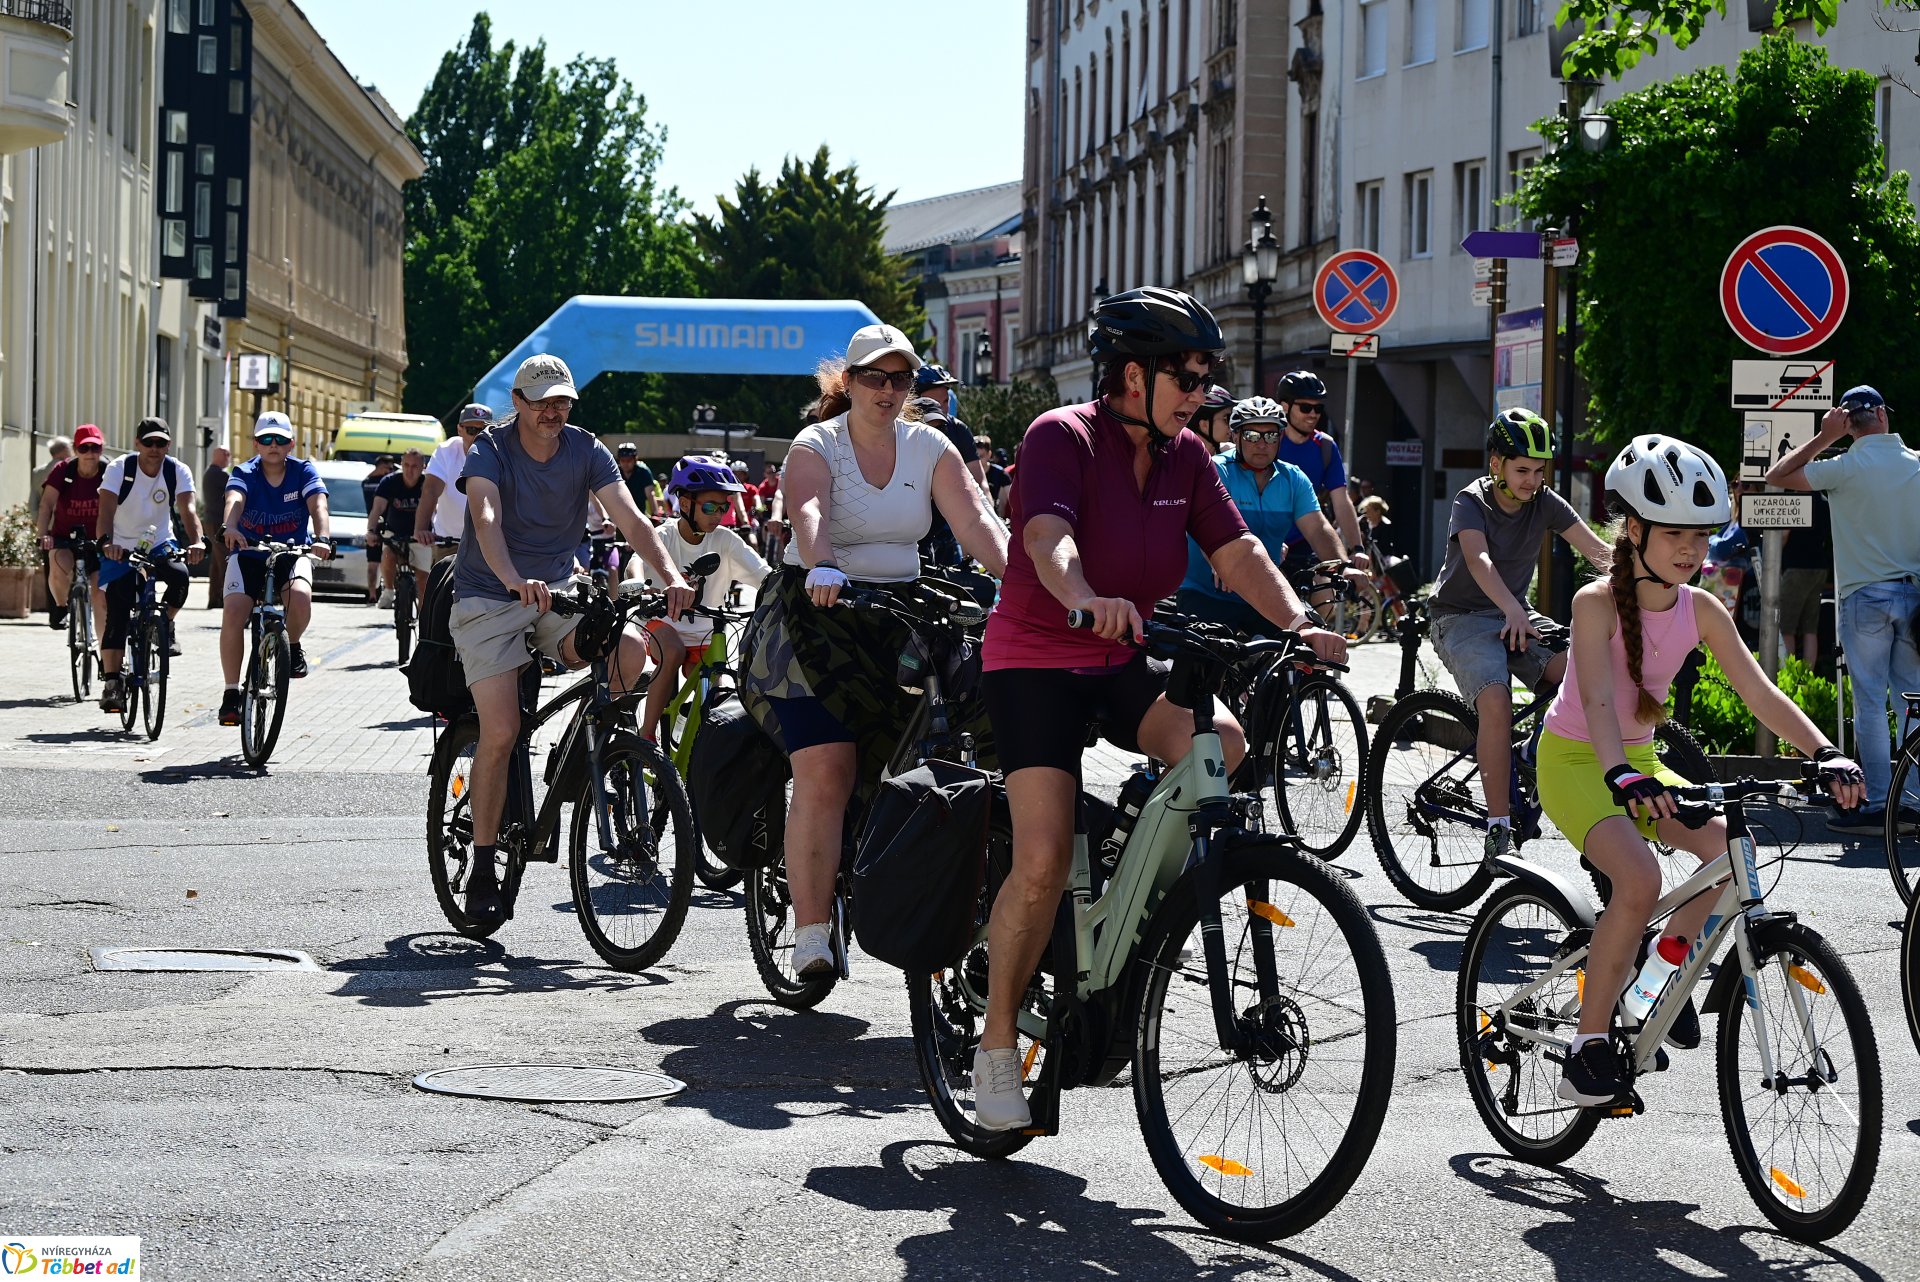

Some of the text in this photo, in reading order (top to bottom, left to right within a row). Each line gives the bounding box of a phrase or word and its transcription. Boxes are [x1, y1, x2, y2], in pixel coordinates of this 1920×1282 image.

[635, 322, 804, 349] SHIMANO
[532, 370, 549, 380] LAKE
[283, 491, 299, 502] GIANT
[1753, 497, 1801, 506] KIZÁRÓLAG
[1747, 516, 1807, 525] ENGEDÉLLYEL
[1743, 837, 1760, 898] GIANT
